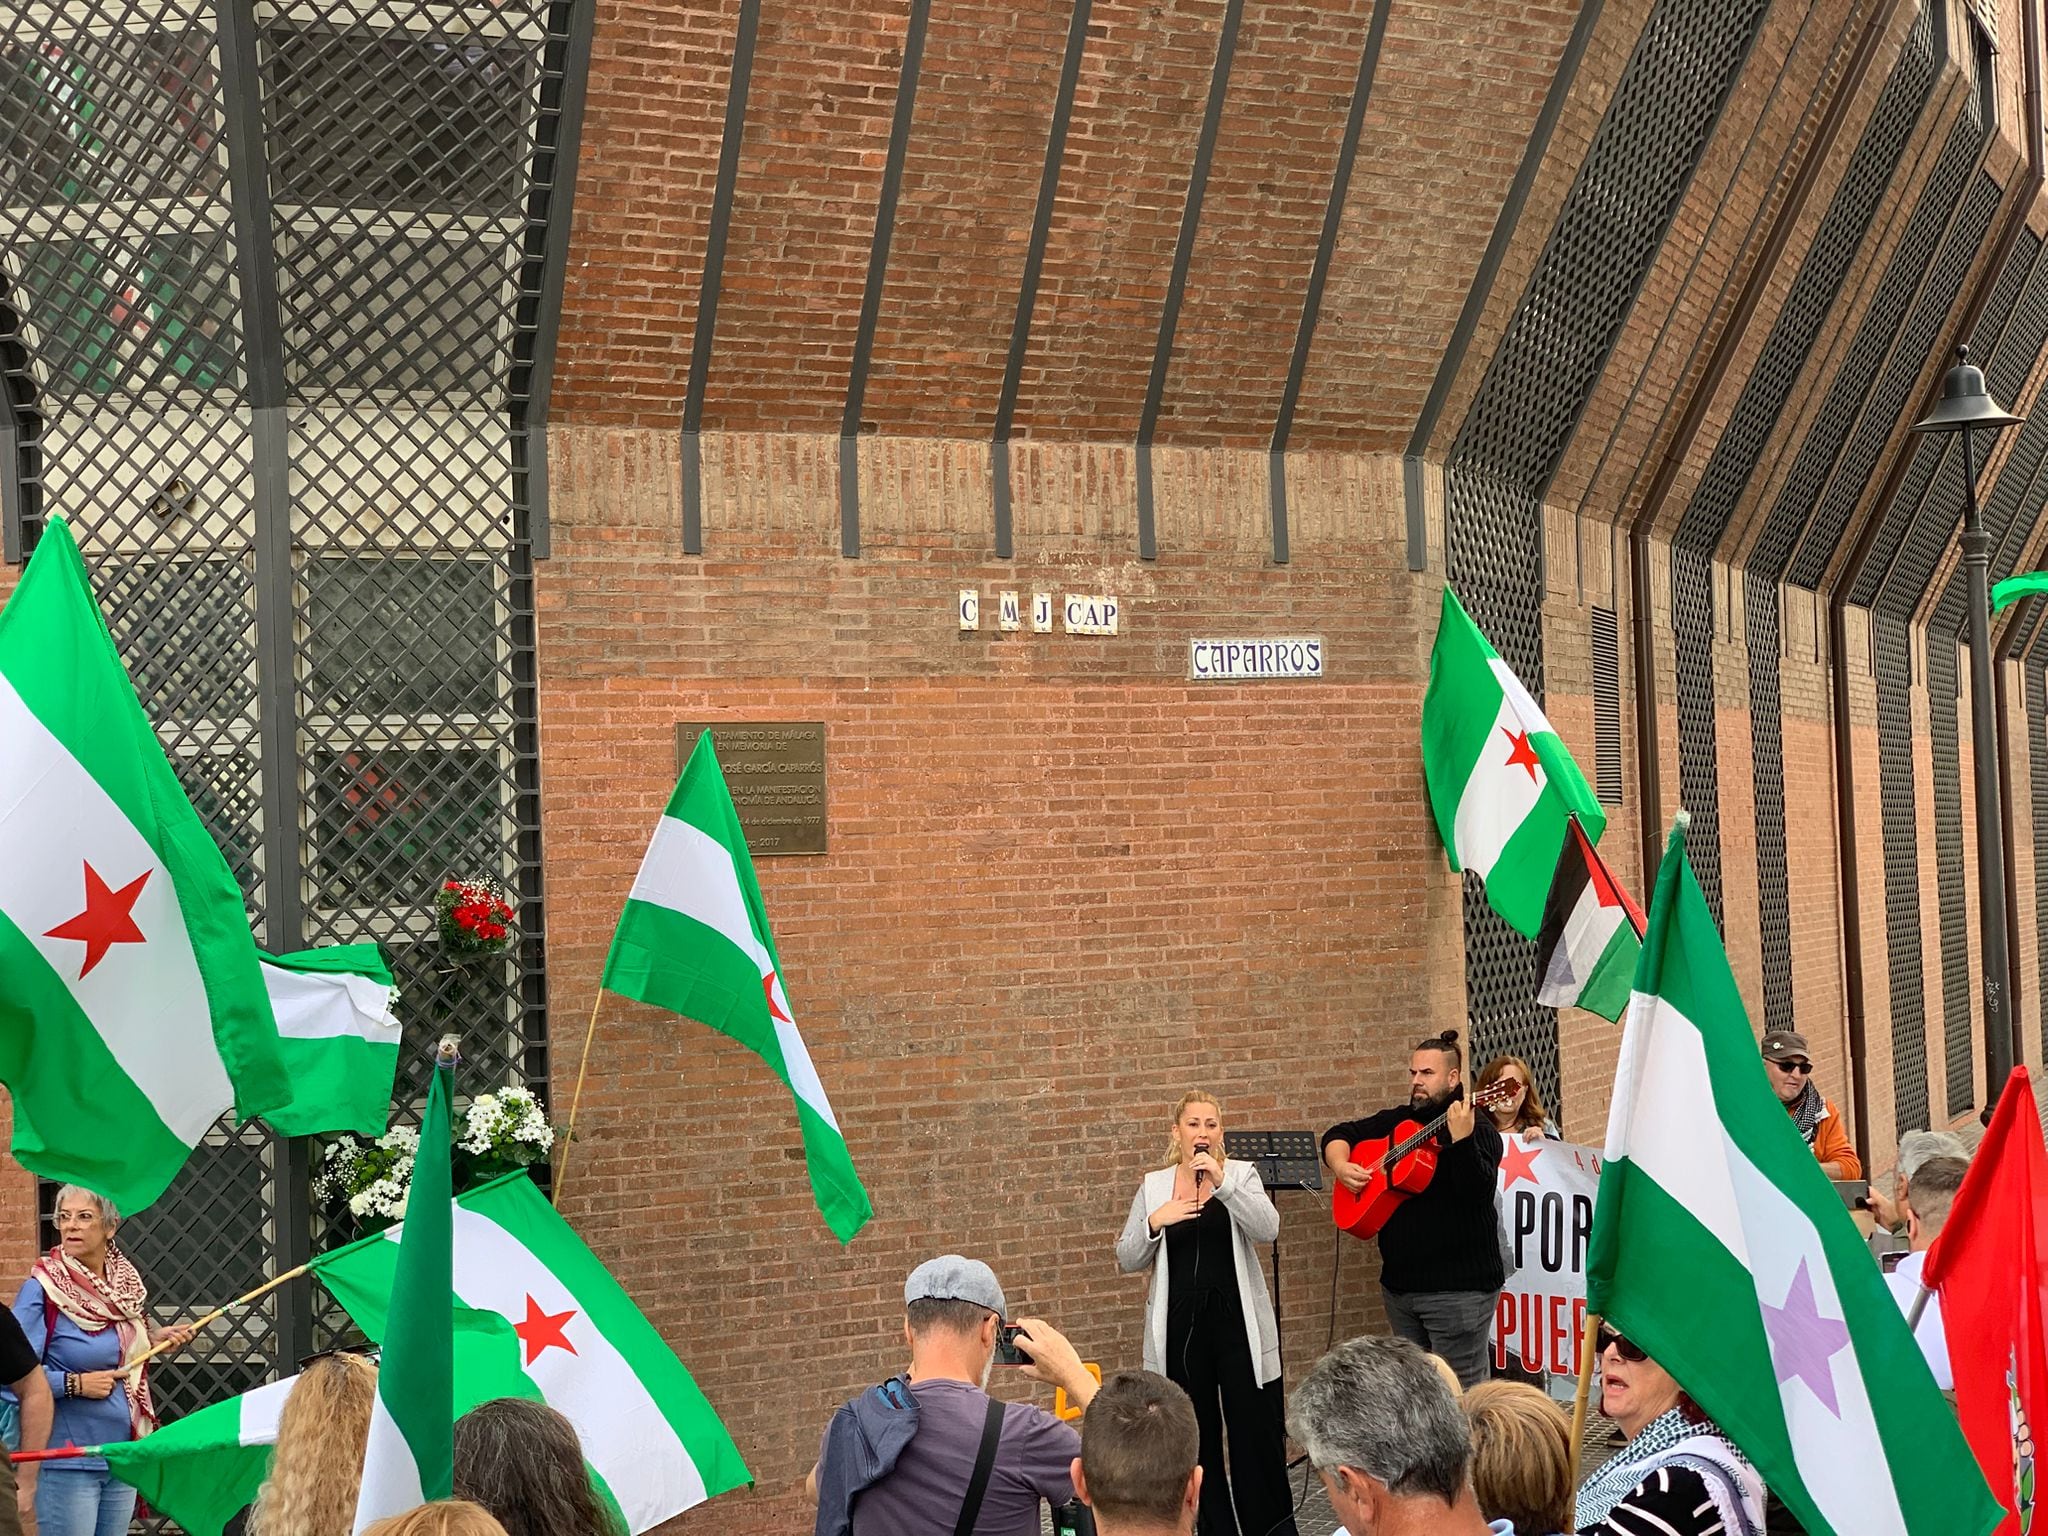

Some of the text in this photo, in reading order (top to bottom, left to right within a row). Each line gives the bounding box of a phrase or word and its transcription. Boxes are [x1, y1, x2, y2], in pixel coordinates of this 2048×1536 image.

[962, 599, 1116, 626] C M J CAP
[686, 731, 696, 741] EL
[768, 731, 780, 741] DE
[781, 729, 818, 741] MÁLAGA
[718, 742, 788, 752] EN MEMORIA DE
[744, 761, 777, 775] GARCÍA
[777, 761, 823, 774] CAPARRÓS
[732, 786, 744, 795] EN
[746, 785, 756, 795] LA
[764, 796, 775, 805] DE
[759, 838, 780, 848] 2017
[1574, 1150, 1585, 1171] 4
[1514, 1190, 1594, 1273] POR
